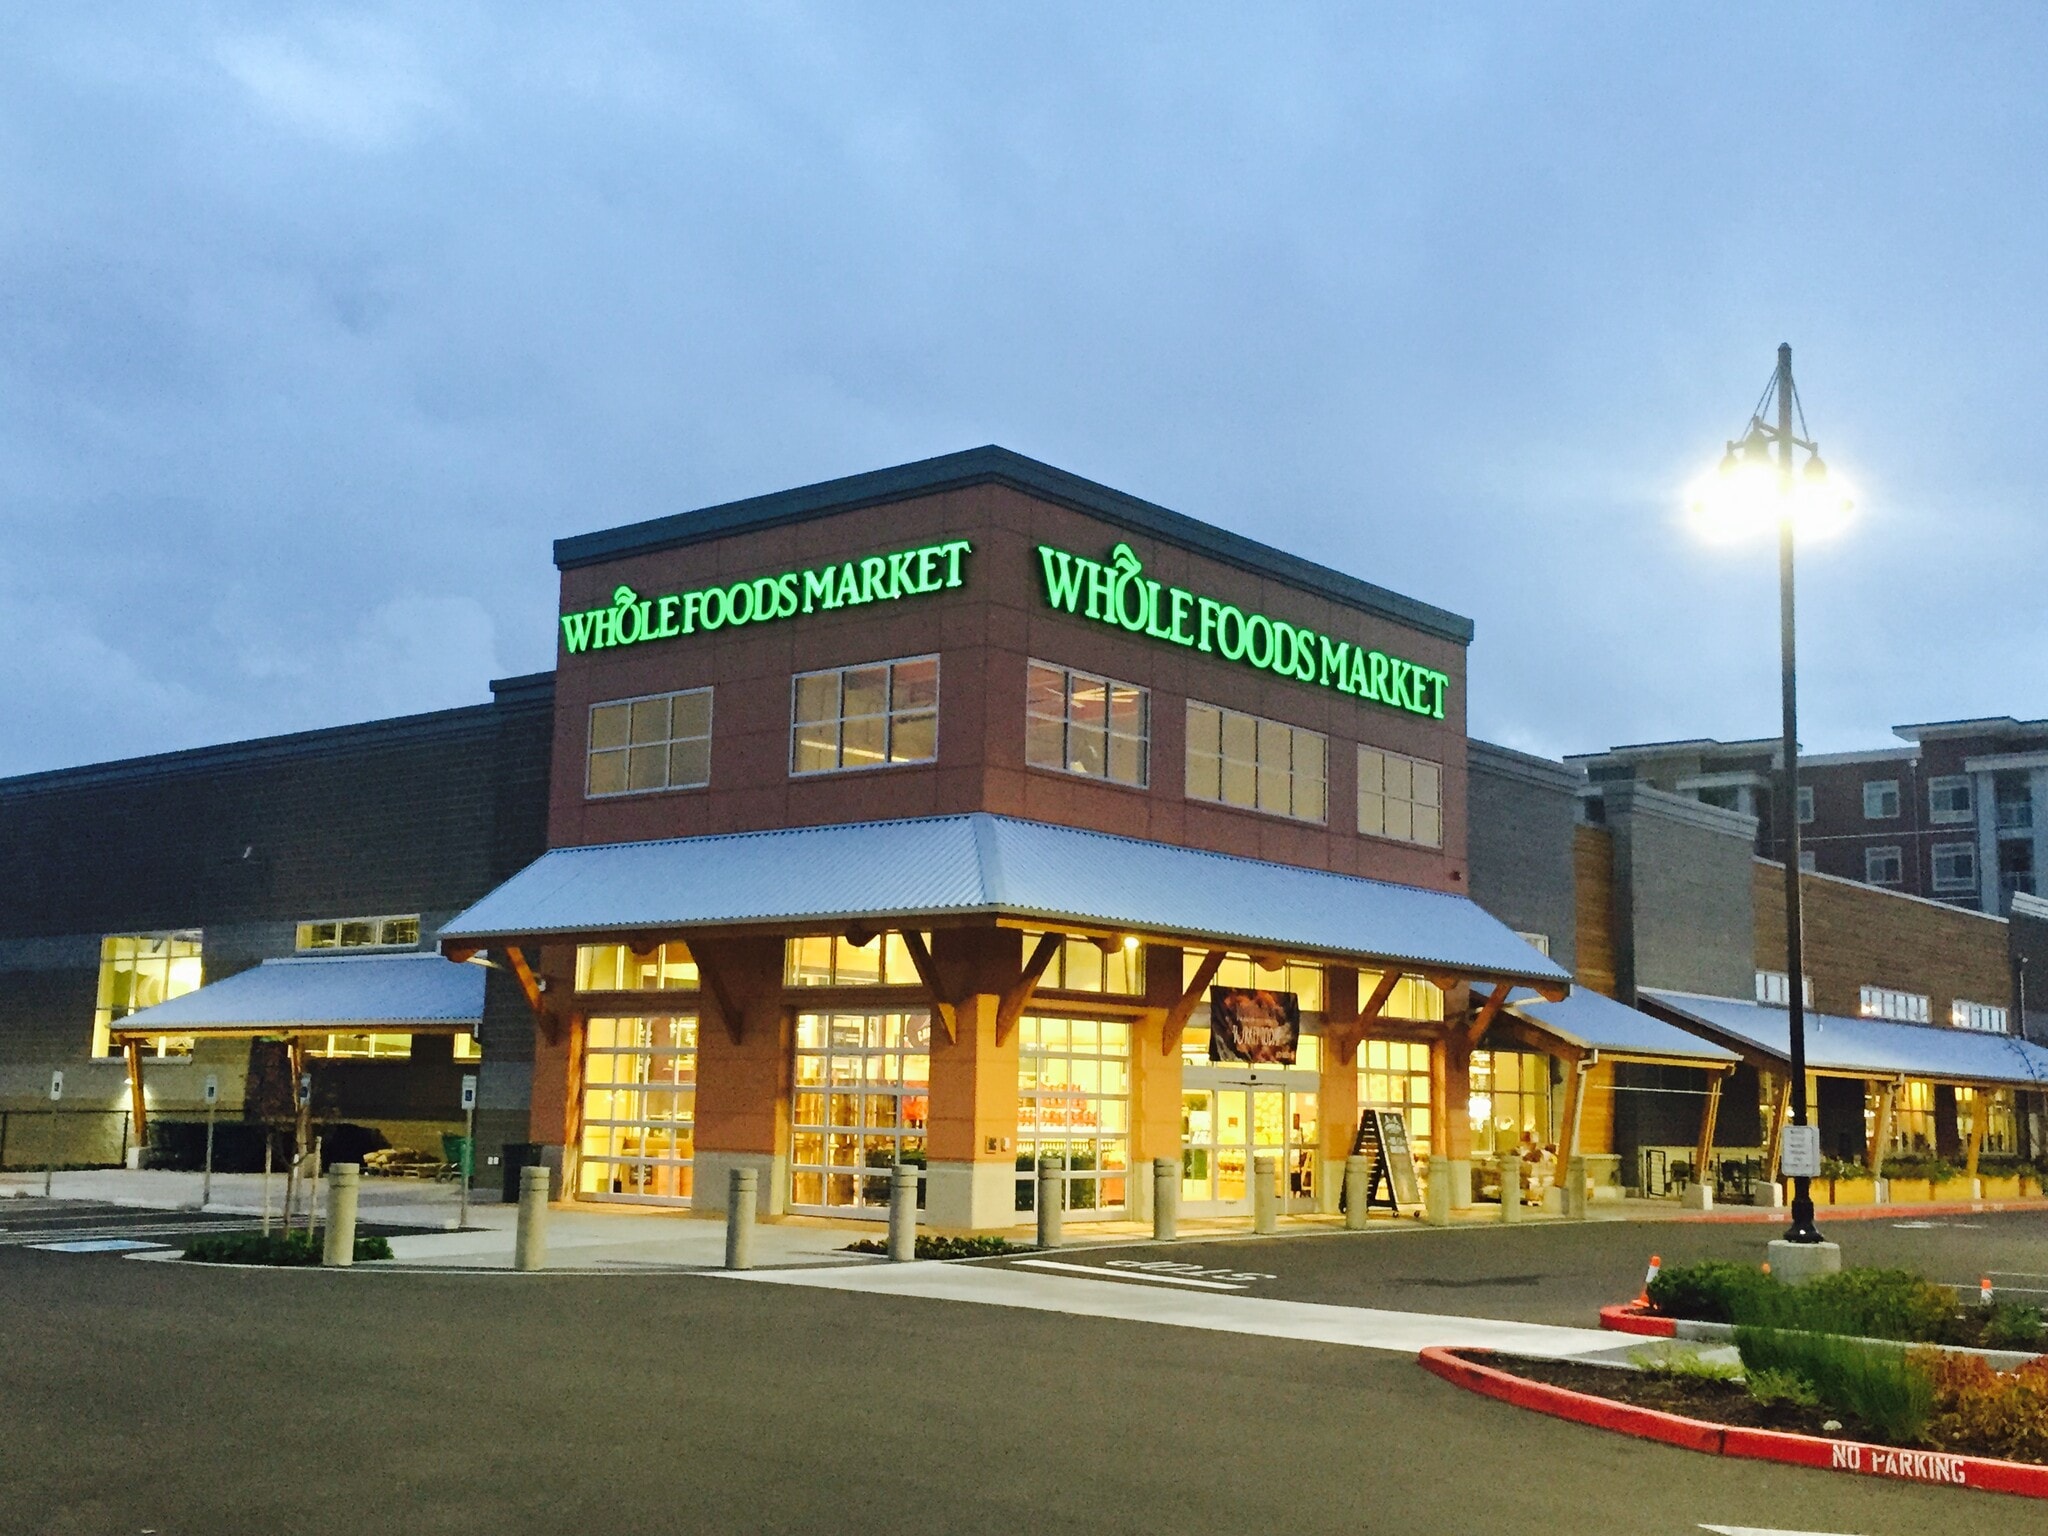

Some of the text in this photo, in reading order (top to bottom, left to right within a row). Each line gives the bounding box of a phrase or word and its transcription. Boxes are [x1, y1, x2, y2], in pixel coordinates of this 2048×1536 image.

[562, 541, 972, 653] WHOLE FOODS MARKET
[1038, 543, 1450, 719] WHOLE FOODS MARKET
[1832, 1444, 1967, 1484] NO PARKING
